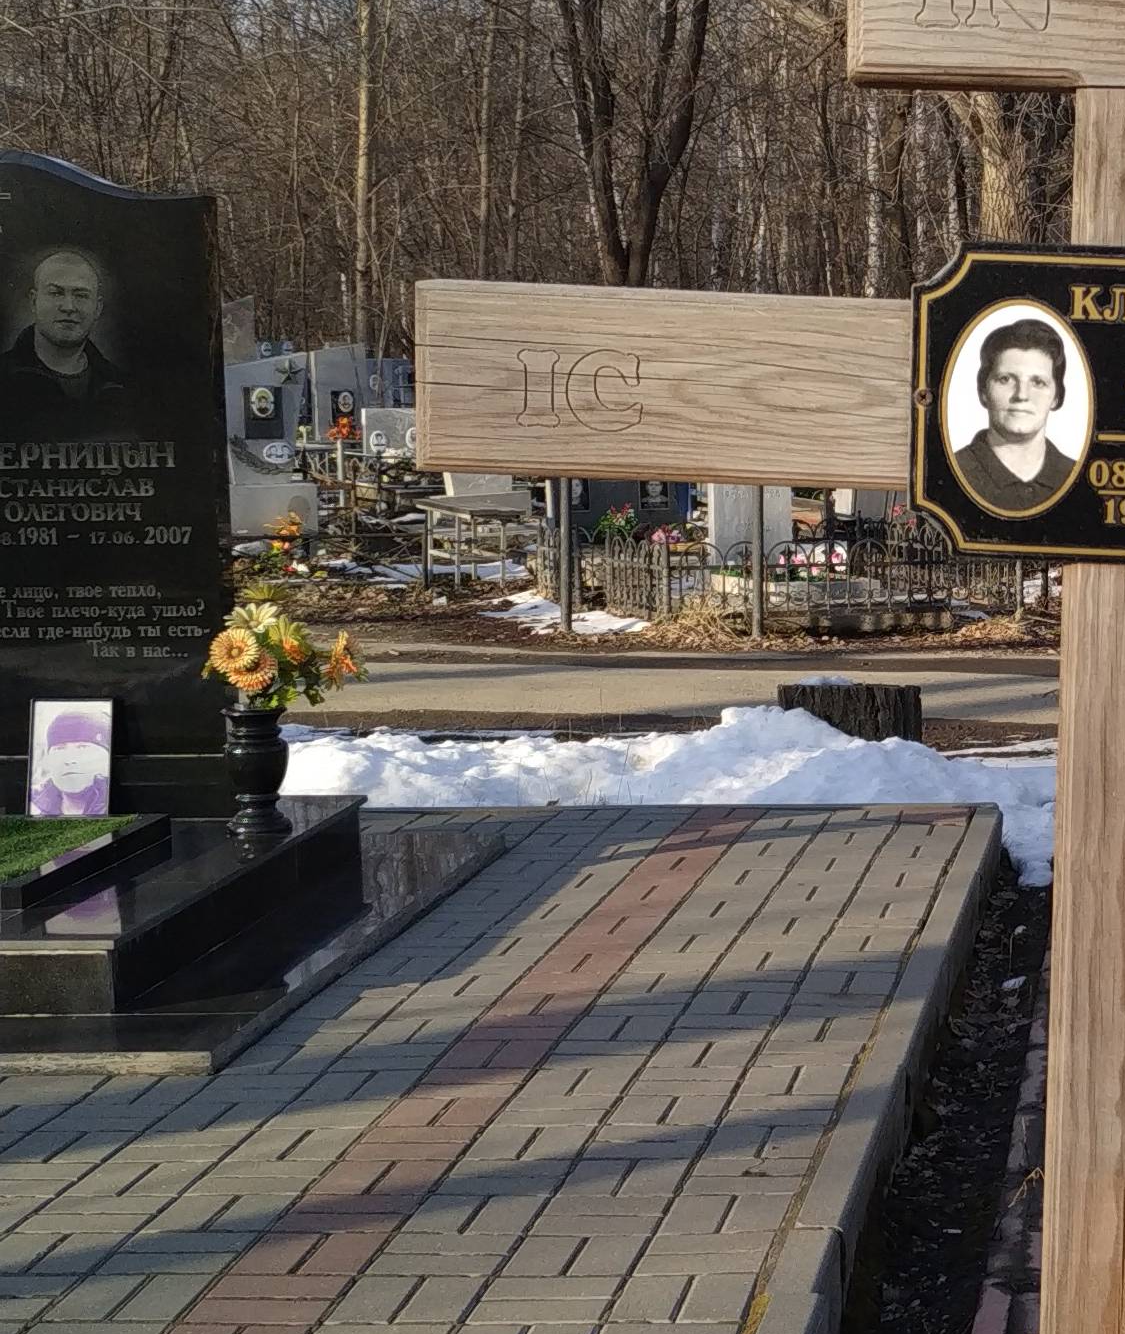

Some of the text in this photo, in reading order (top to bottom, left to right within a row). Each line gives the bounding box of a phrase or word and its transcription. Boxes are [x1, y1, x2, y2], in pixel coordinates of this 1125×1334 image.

[4, 500, 143, 523] ОЛЕГОВИЧ
[12, 586, 60, 603] лицо,
[66, 585, 103, 598] твое
[109, 584, 162, 600] тепло,
[1, 599, 45, 619] Твое
[152, 598, 206, 621] ушло?
[0, 625, 31, 639] сли
[38, 621, 132, 641] где-нибудь
[138, 625, 161, 637] ты
[86, 639, 120, 658] Так
[126, 646, 136, 658] в
